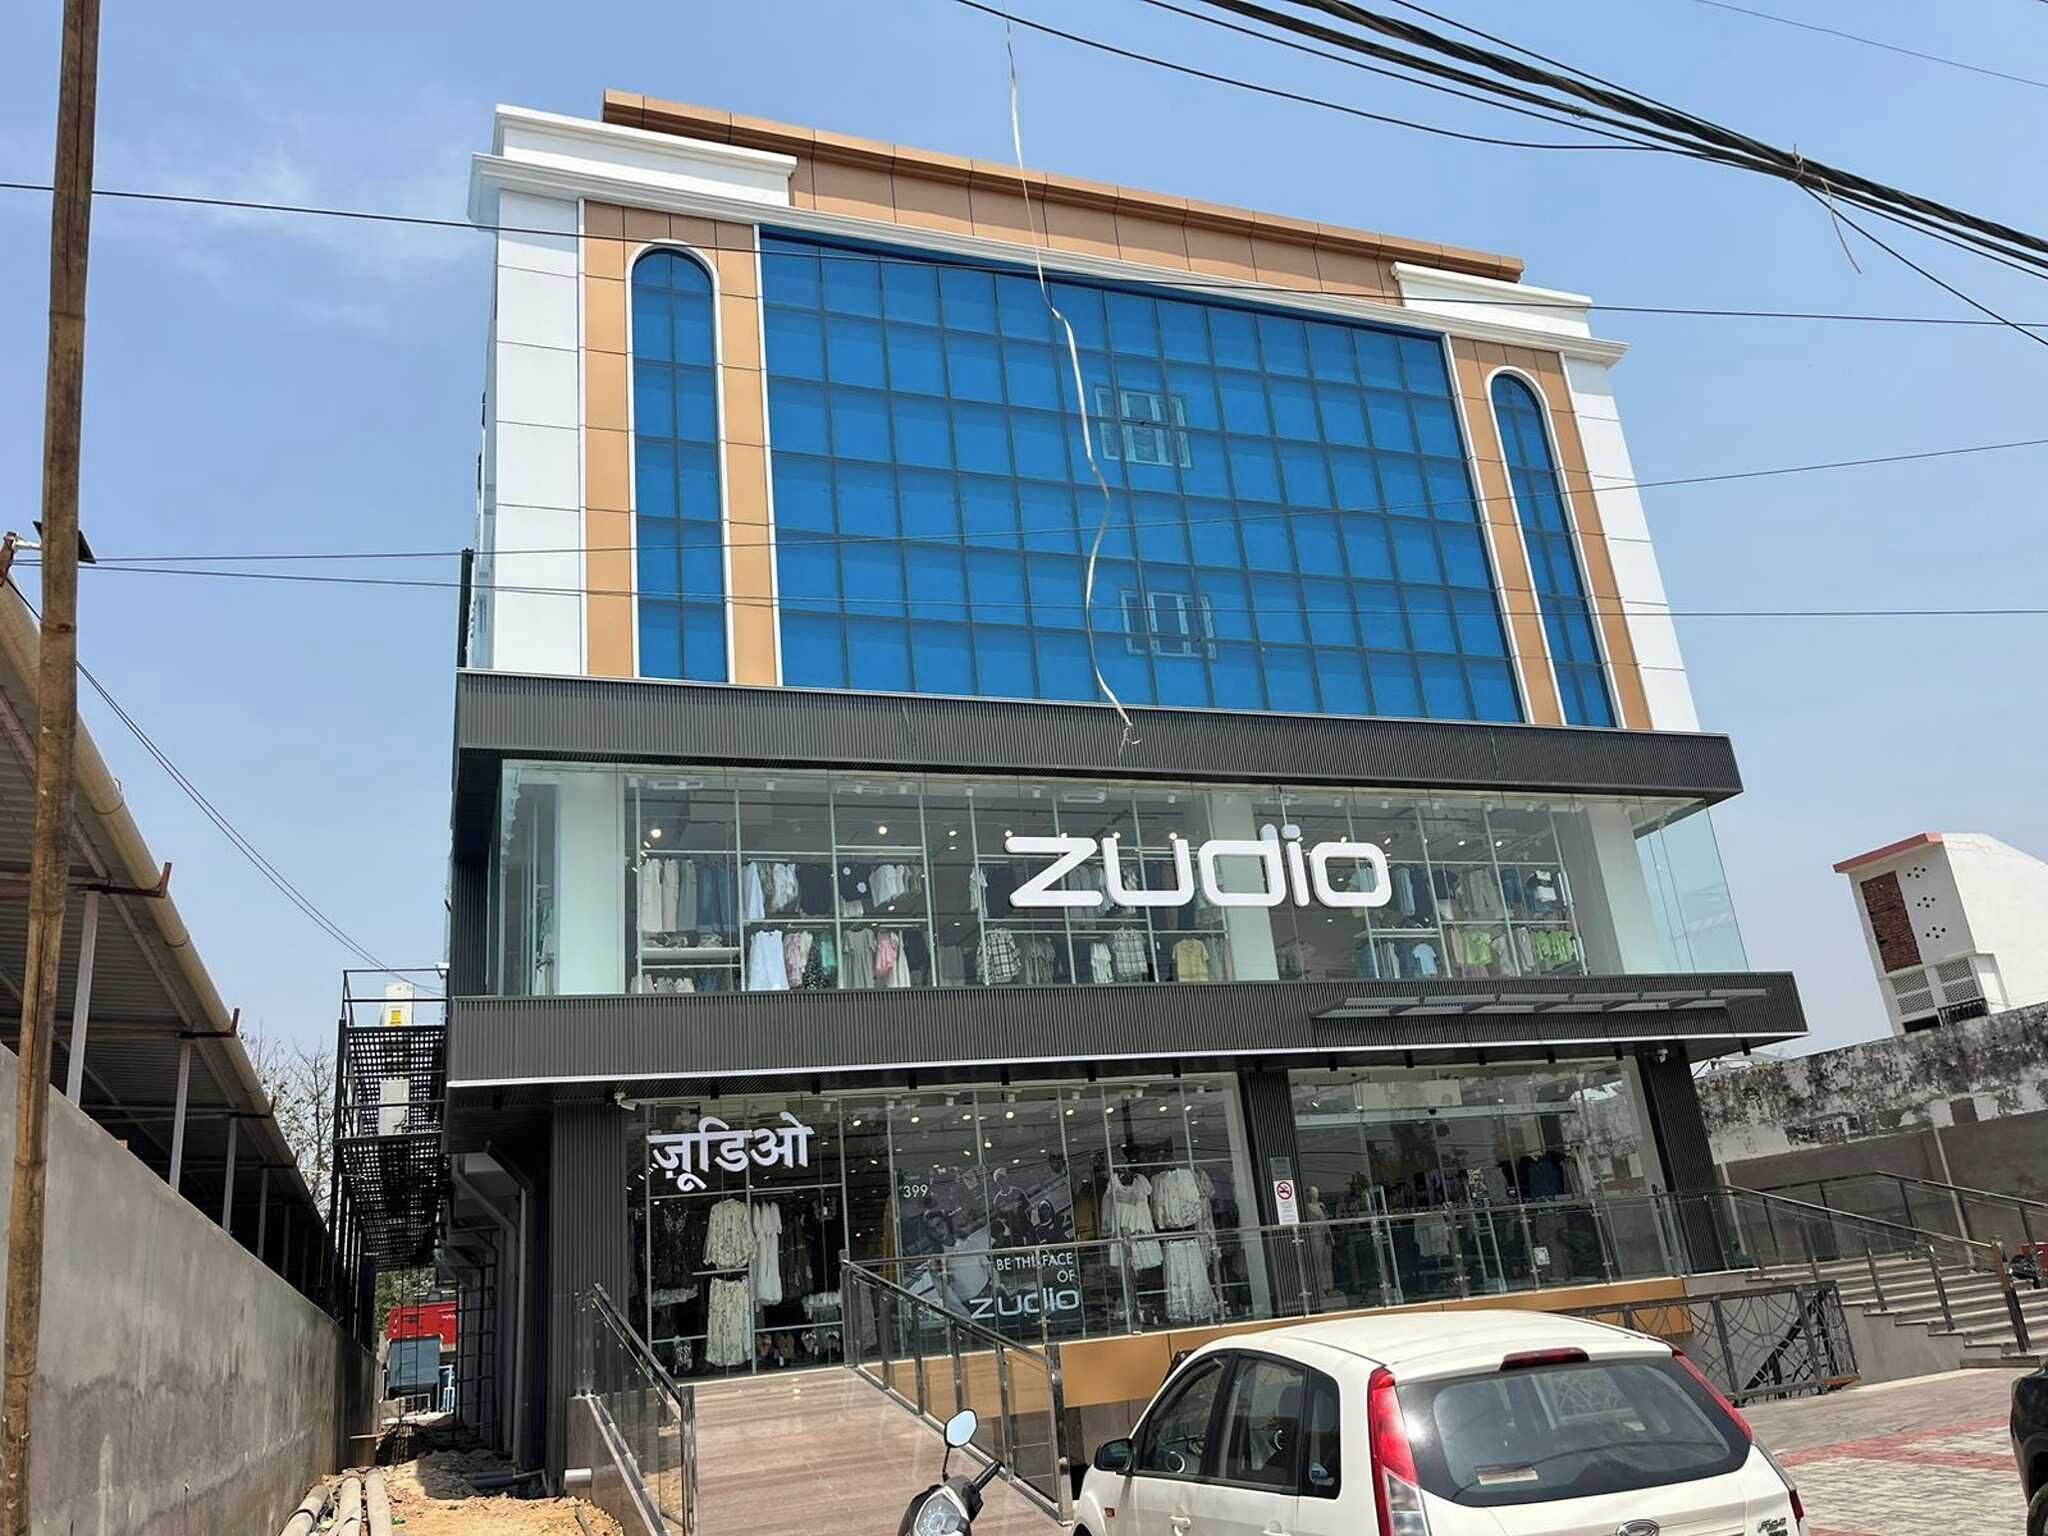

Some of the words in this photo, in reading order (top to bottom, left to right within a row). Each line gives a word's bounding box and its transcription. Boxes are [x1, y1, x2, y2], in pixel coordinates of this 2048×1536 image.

[1005, 823, 1393, 908] zudio
[646, 1111, 816, 1192] ज़ूडिओ
[903, 1184, 928, 1198] 399
[996, 1257, 1012, 1271] BE
[1042, 1252, 1073, 1266] FACE
[1056, 1269, 1076, 1283] OF
